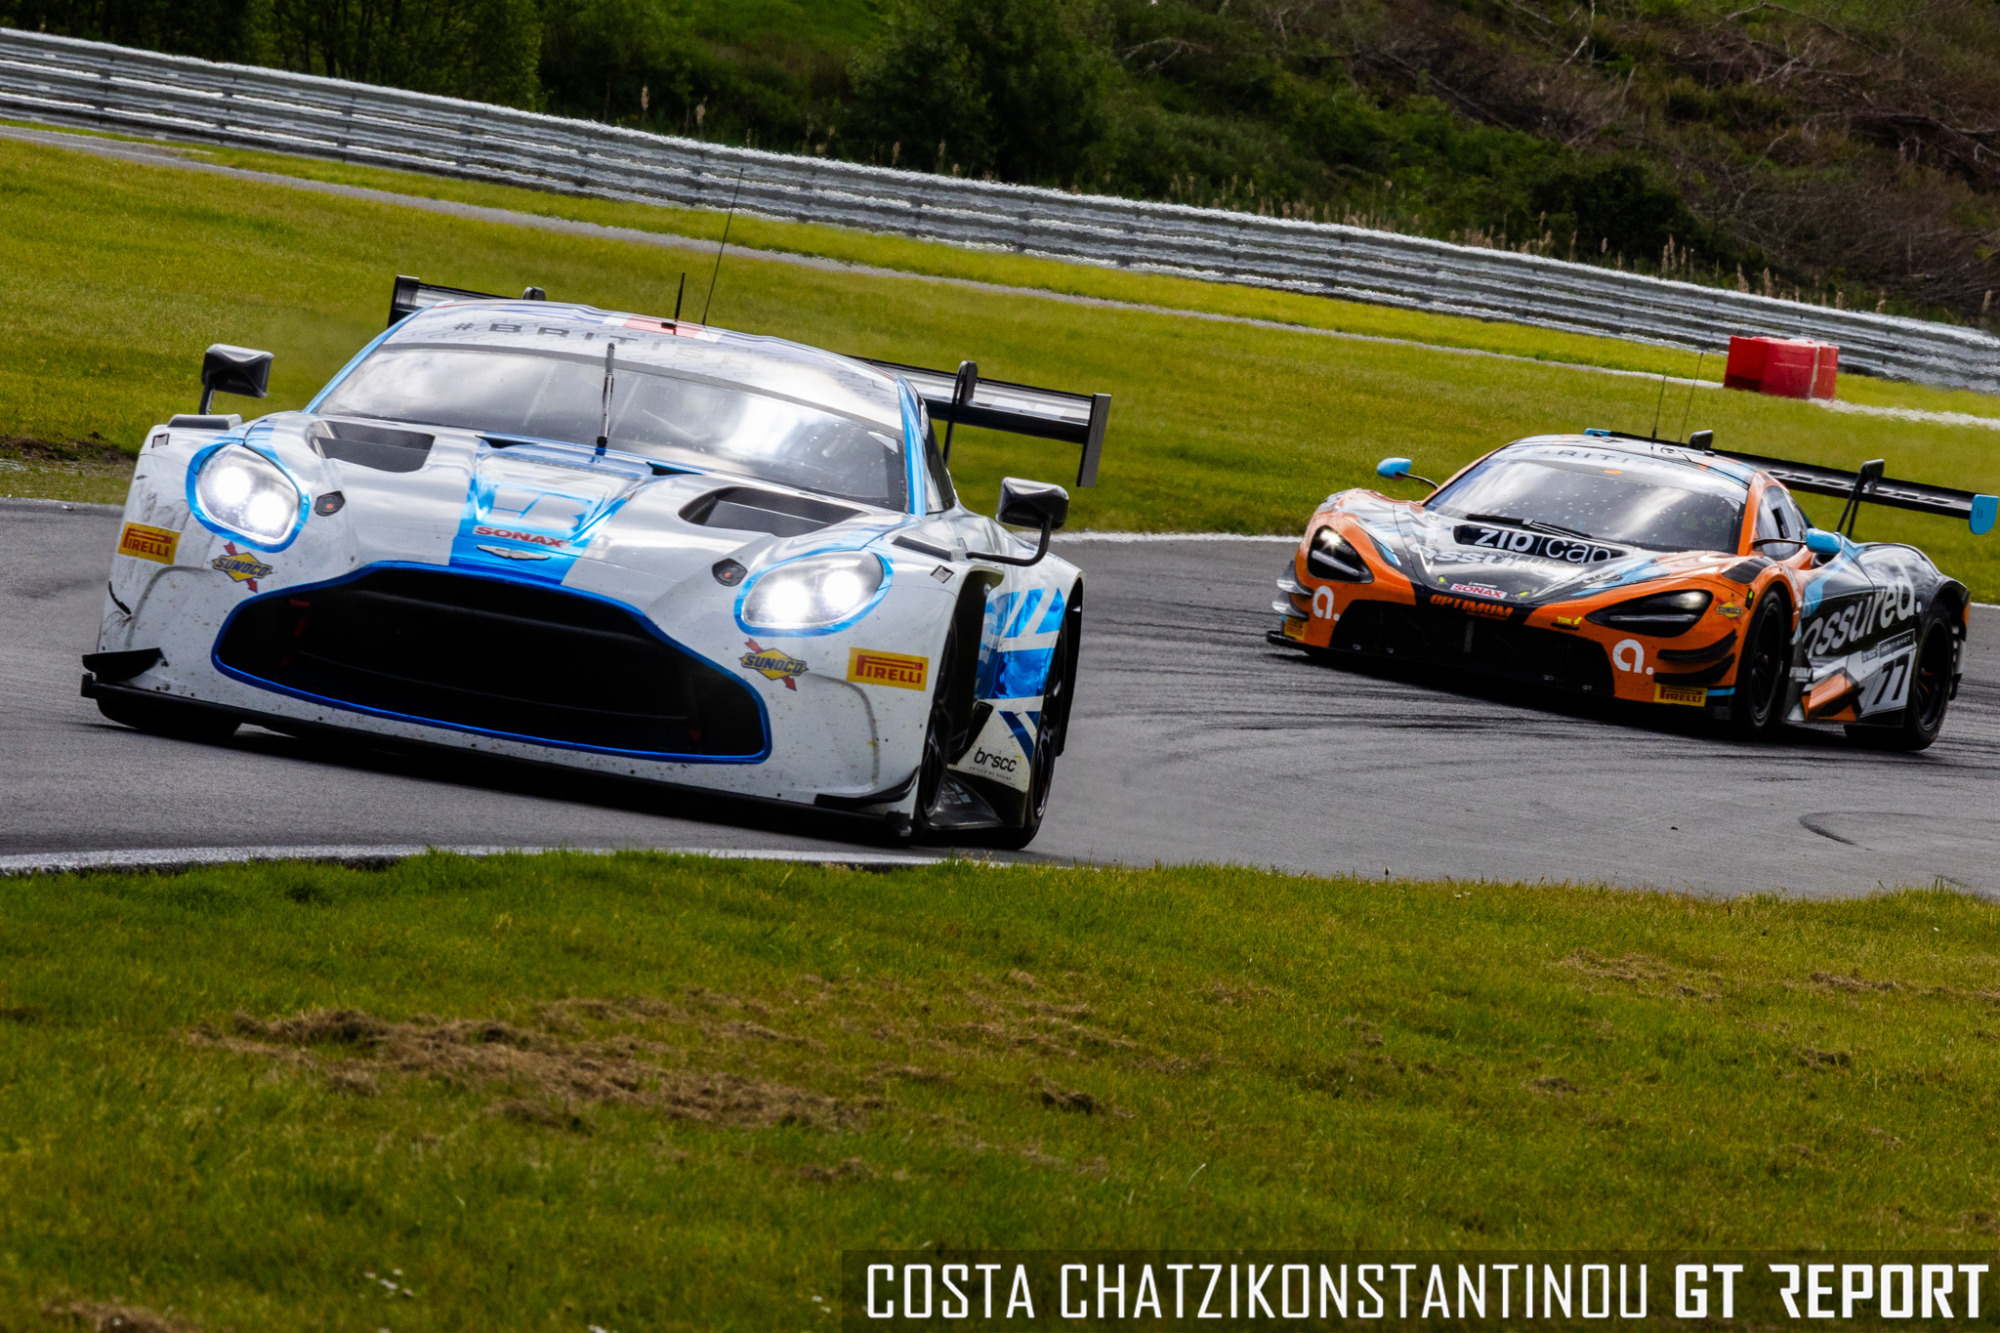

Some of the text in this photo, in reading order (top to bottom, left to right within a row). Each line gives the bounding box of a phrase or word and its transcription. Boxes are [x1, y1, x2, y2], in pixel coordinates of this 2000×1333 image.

[123, 527, 174, 557] PIRELLI
[474, 526, 569, 549] SONAX
[214, 556, 271, 577] SUNOCO
[1453, 583, 1504, 598] SONAX
[1429, 593, 1514, 617] OPTIMUM
[744, 653, 805, 676] SUNOCO
[856, 653, 924, 685] PIRELLI
[1872, 651, 1910, 706] 77
[1659, 685, 1703, 703] PIRELLI
[974, 746, 1017, 773] brscc
